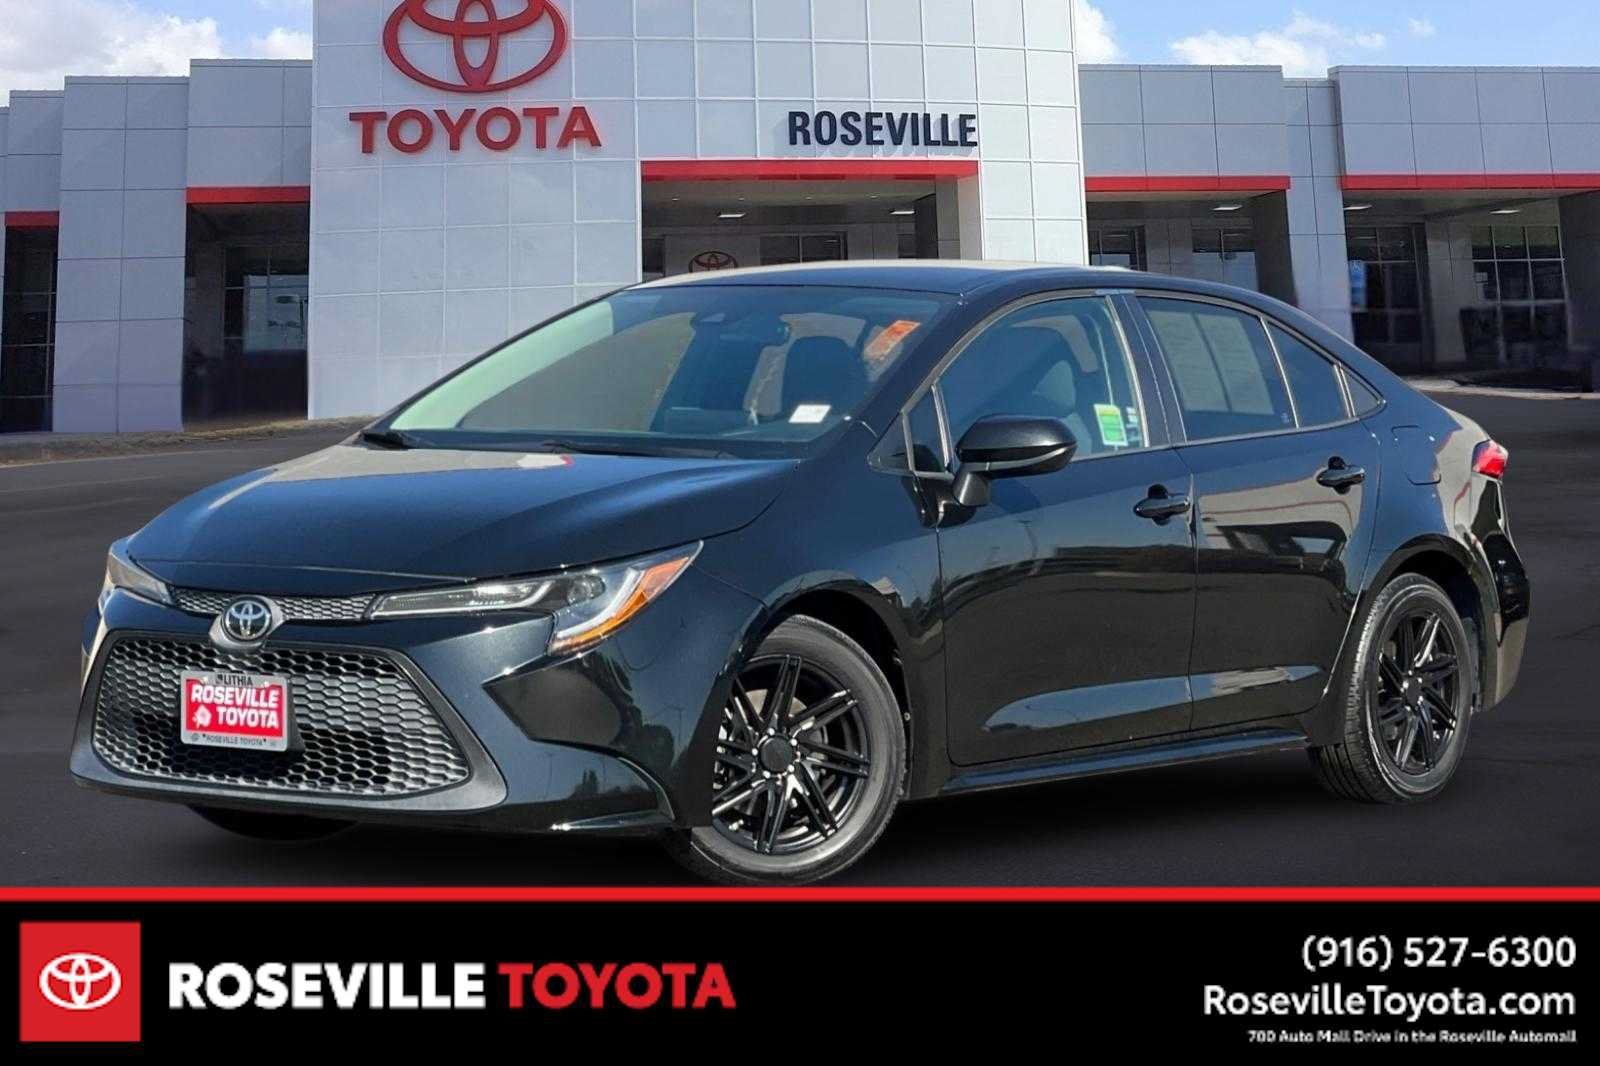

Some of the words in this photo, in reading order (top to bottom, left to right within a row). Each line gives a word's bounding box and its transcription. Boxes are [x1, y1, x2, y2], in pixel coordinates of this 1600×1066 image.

[349, 106, 602, 153] TOYOTA
[789, 110, 978, 147] ROSEVILLE
[223, 674, 253, 686] LITHIA
[191, 684, 280, 709] ROSEVILLE
[216, 706, 280, 729] TOYOTA
